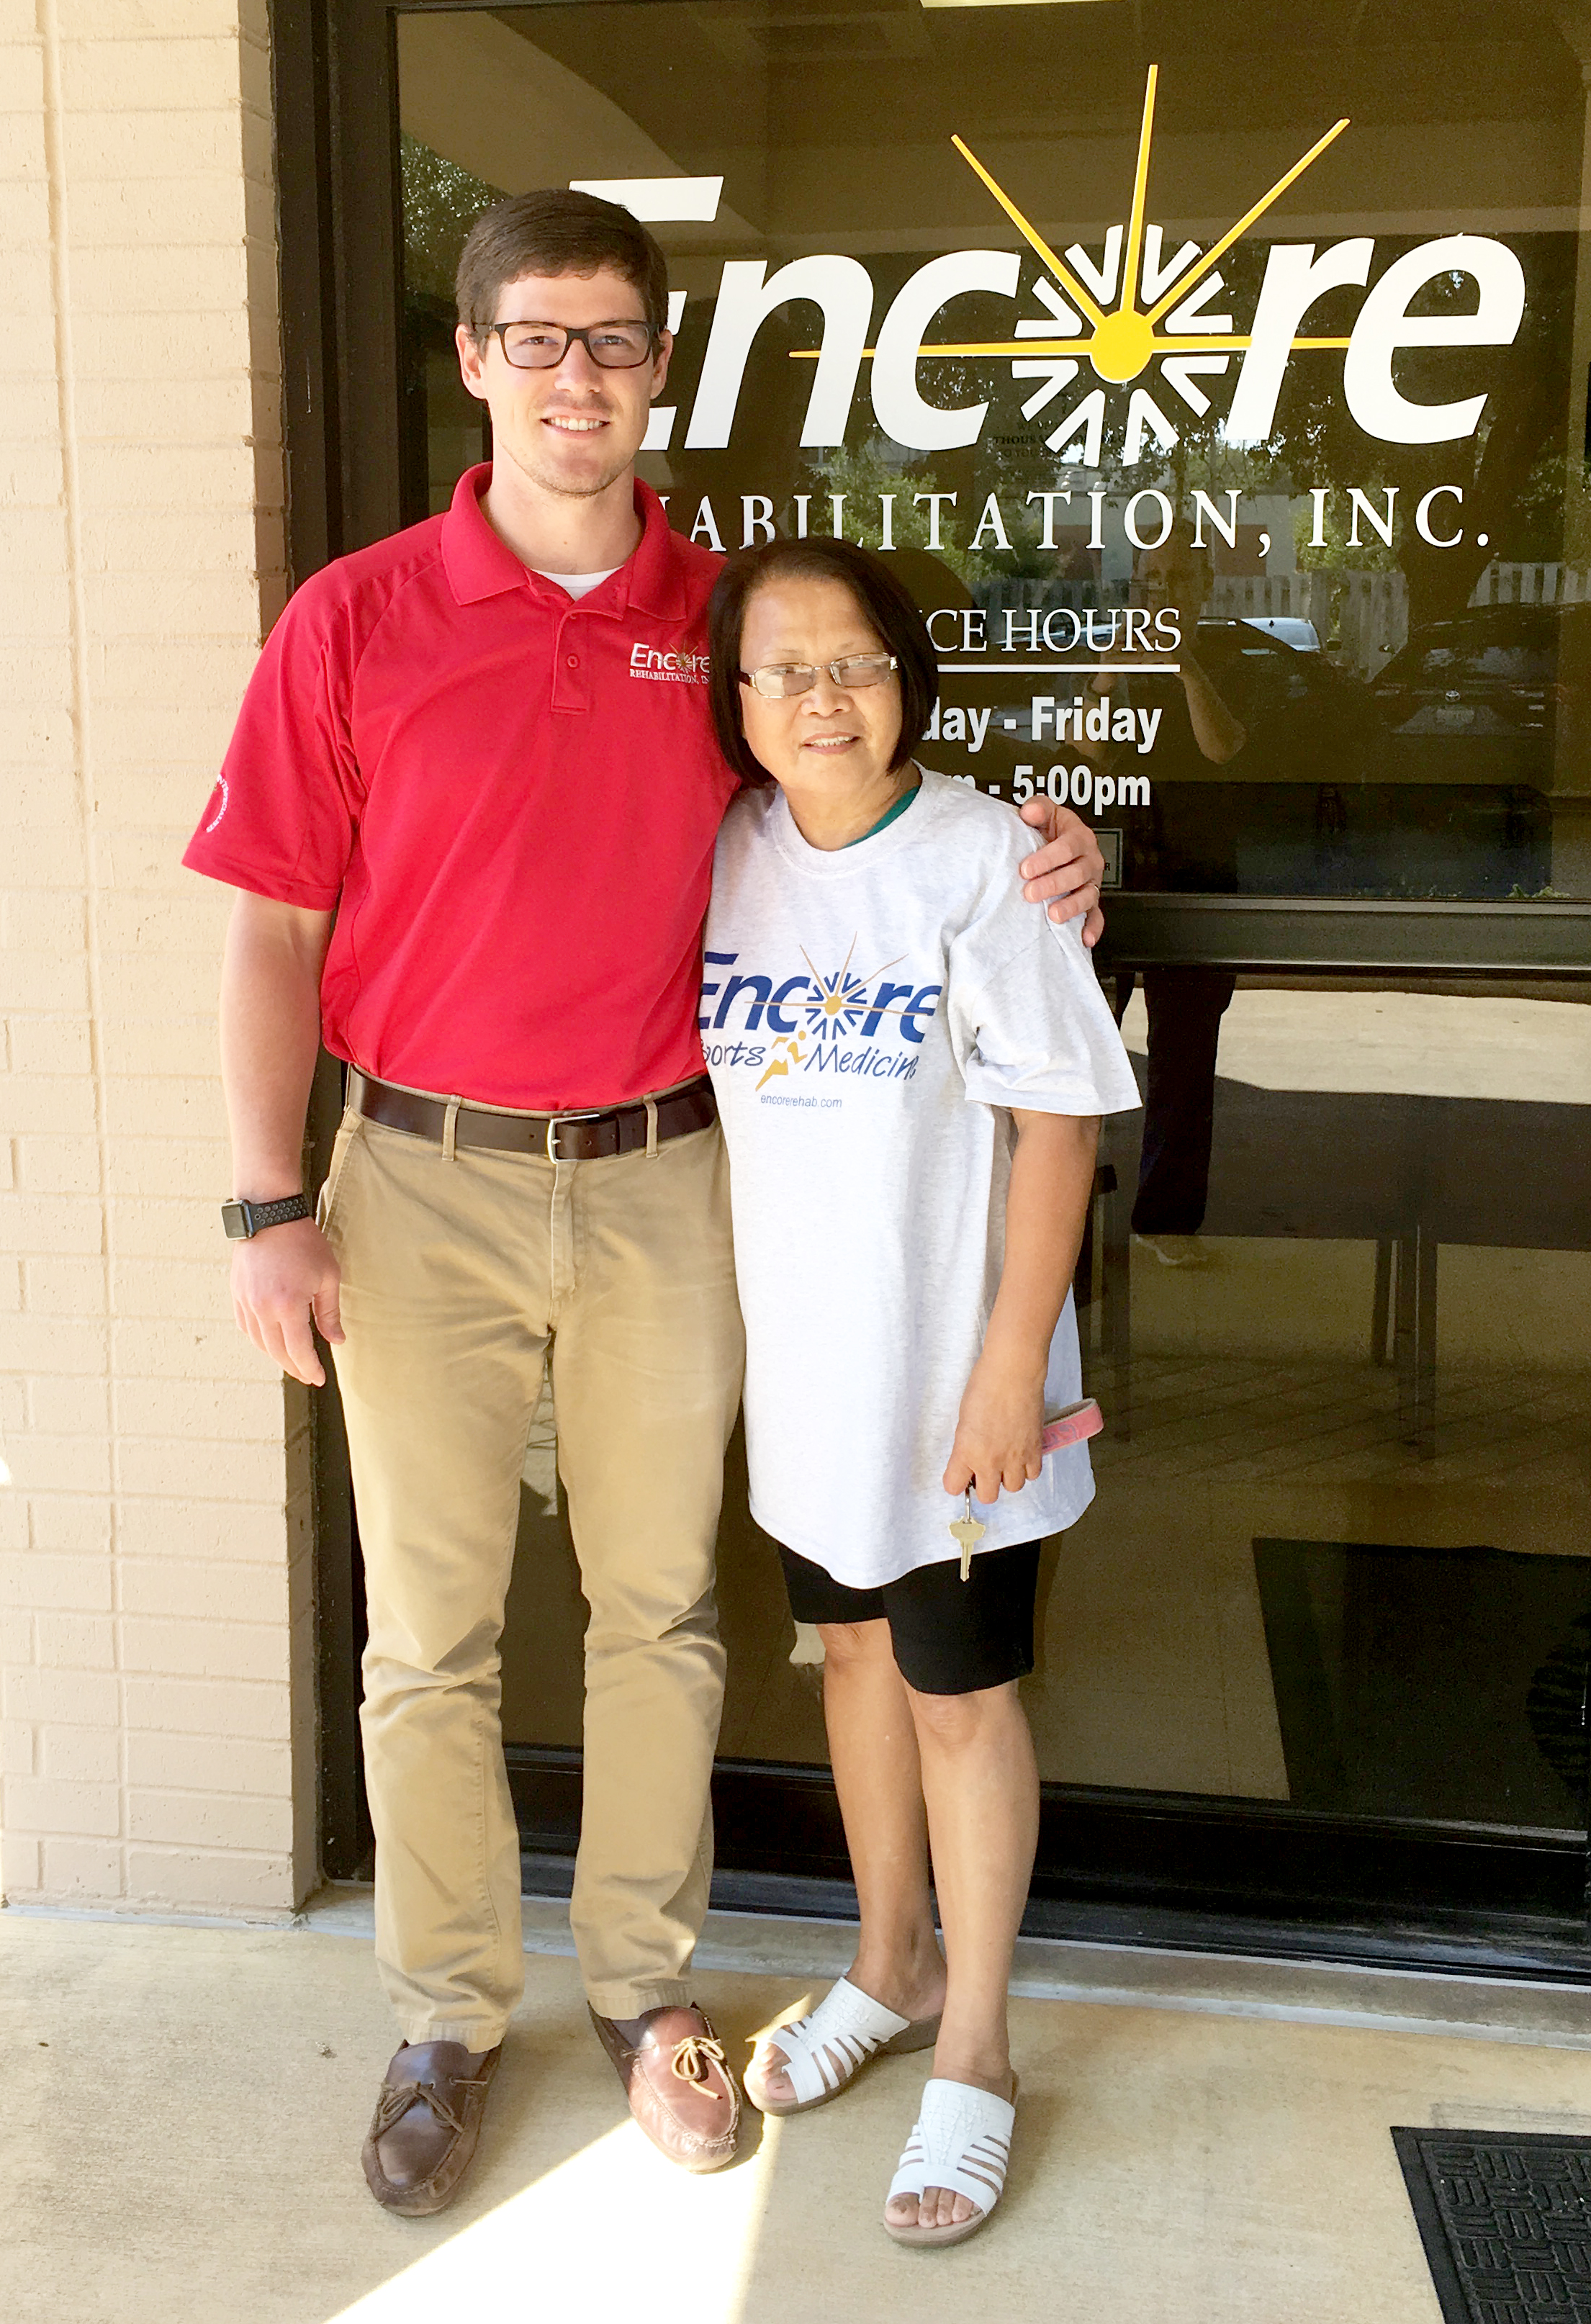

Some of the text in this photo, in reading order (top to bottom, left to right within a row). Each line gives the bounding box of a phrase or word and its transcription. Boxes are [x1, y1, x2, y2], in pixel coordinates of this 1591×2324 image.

[569, 176, 1525, 467] ncore
[659, 485, 1489, 557] ABILITATION, INC.
[1001, 608, 1181, 652] HOURS
[630, 669, 699, 685] REHABILITATION,
[1004, 719, 1017, 729] -
[1032, 696, 1163, 754] Friday
[1012, 765, 1150, 816] 5:00pm
[760, 1094, 842, 1108] encorerehab.com
